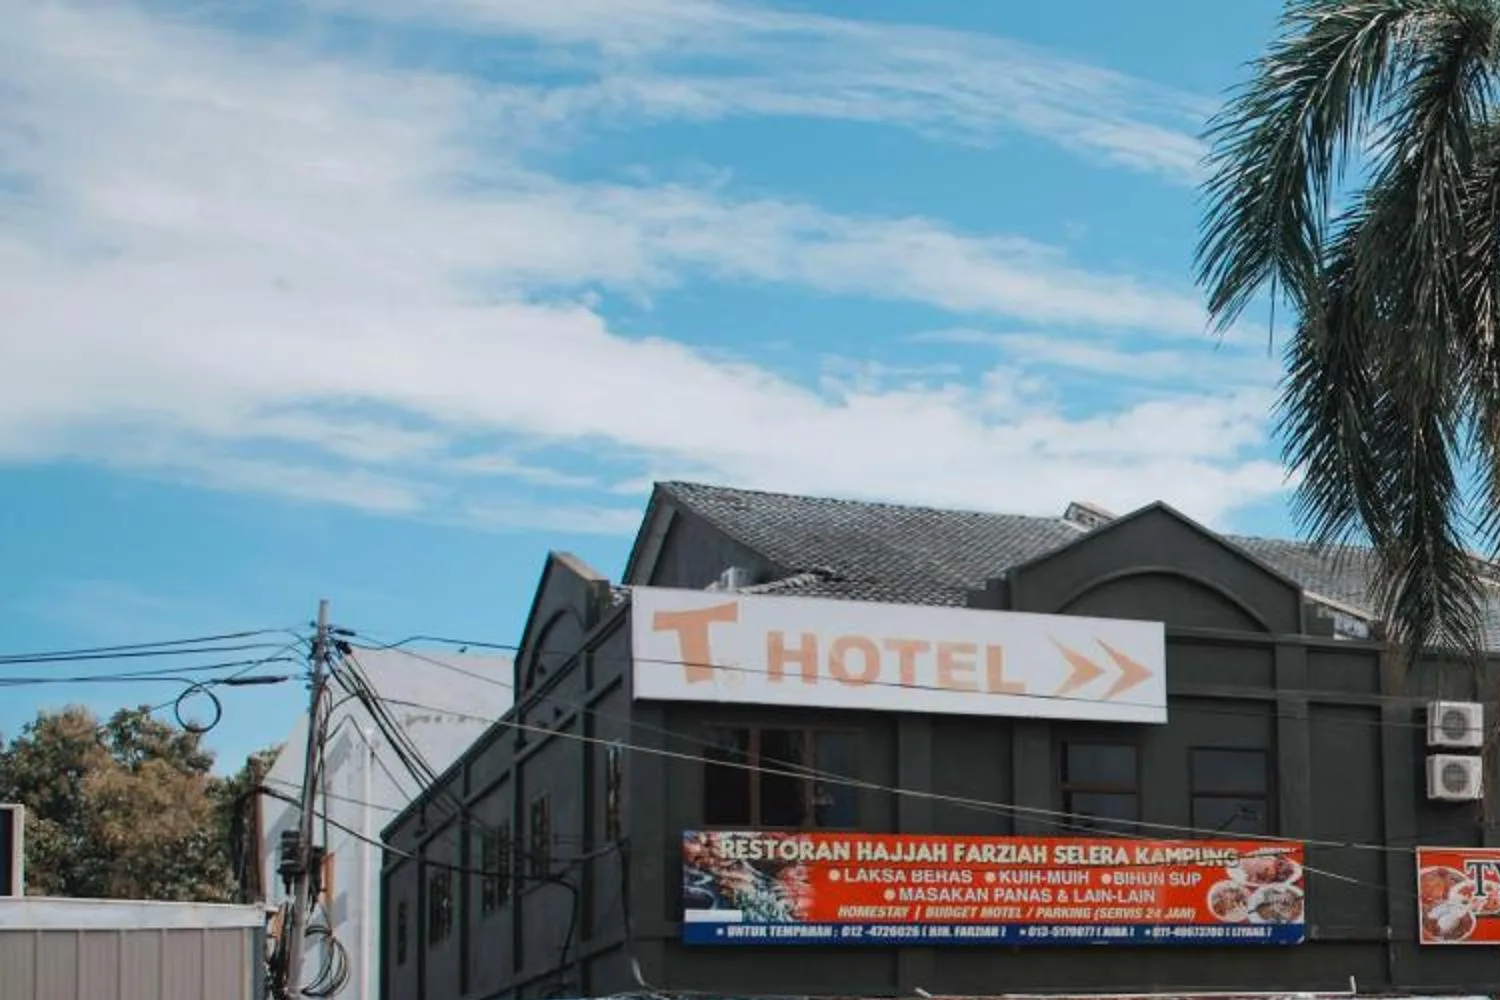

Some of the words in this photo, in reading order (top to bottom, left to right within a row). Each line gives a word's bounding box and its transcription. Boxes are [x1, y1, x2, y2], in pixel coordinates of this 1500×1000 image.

[653, 601, 738, 685] T
[766, 631, 1027, 695] HOTEL
[719, 839, 849, 861] RESTORAN
[856, 842, 947, 862] HAJJAH
[954, 843, 1047, 864] FARZIAH
[1055, 845, 1129, 865] SELERA
[1135, 846, 1240, 868] KAMPUNG
[845, 868, 906, 883] LAKSA
[1000, 870, 1090, 885] KUIH-MUIH
[1114, 871, 1164, 886] BIHUN
[1169, 872, 1202, 886] SUP
[899, 887, 988, 902] MASAKAN
[993, 888, 1053, 903] PANAS
[1058, 889, 1069, 902] &
[1074, 889, 1156, 903] LAIN-LAIN
